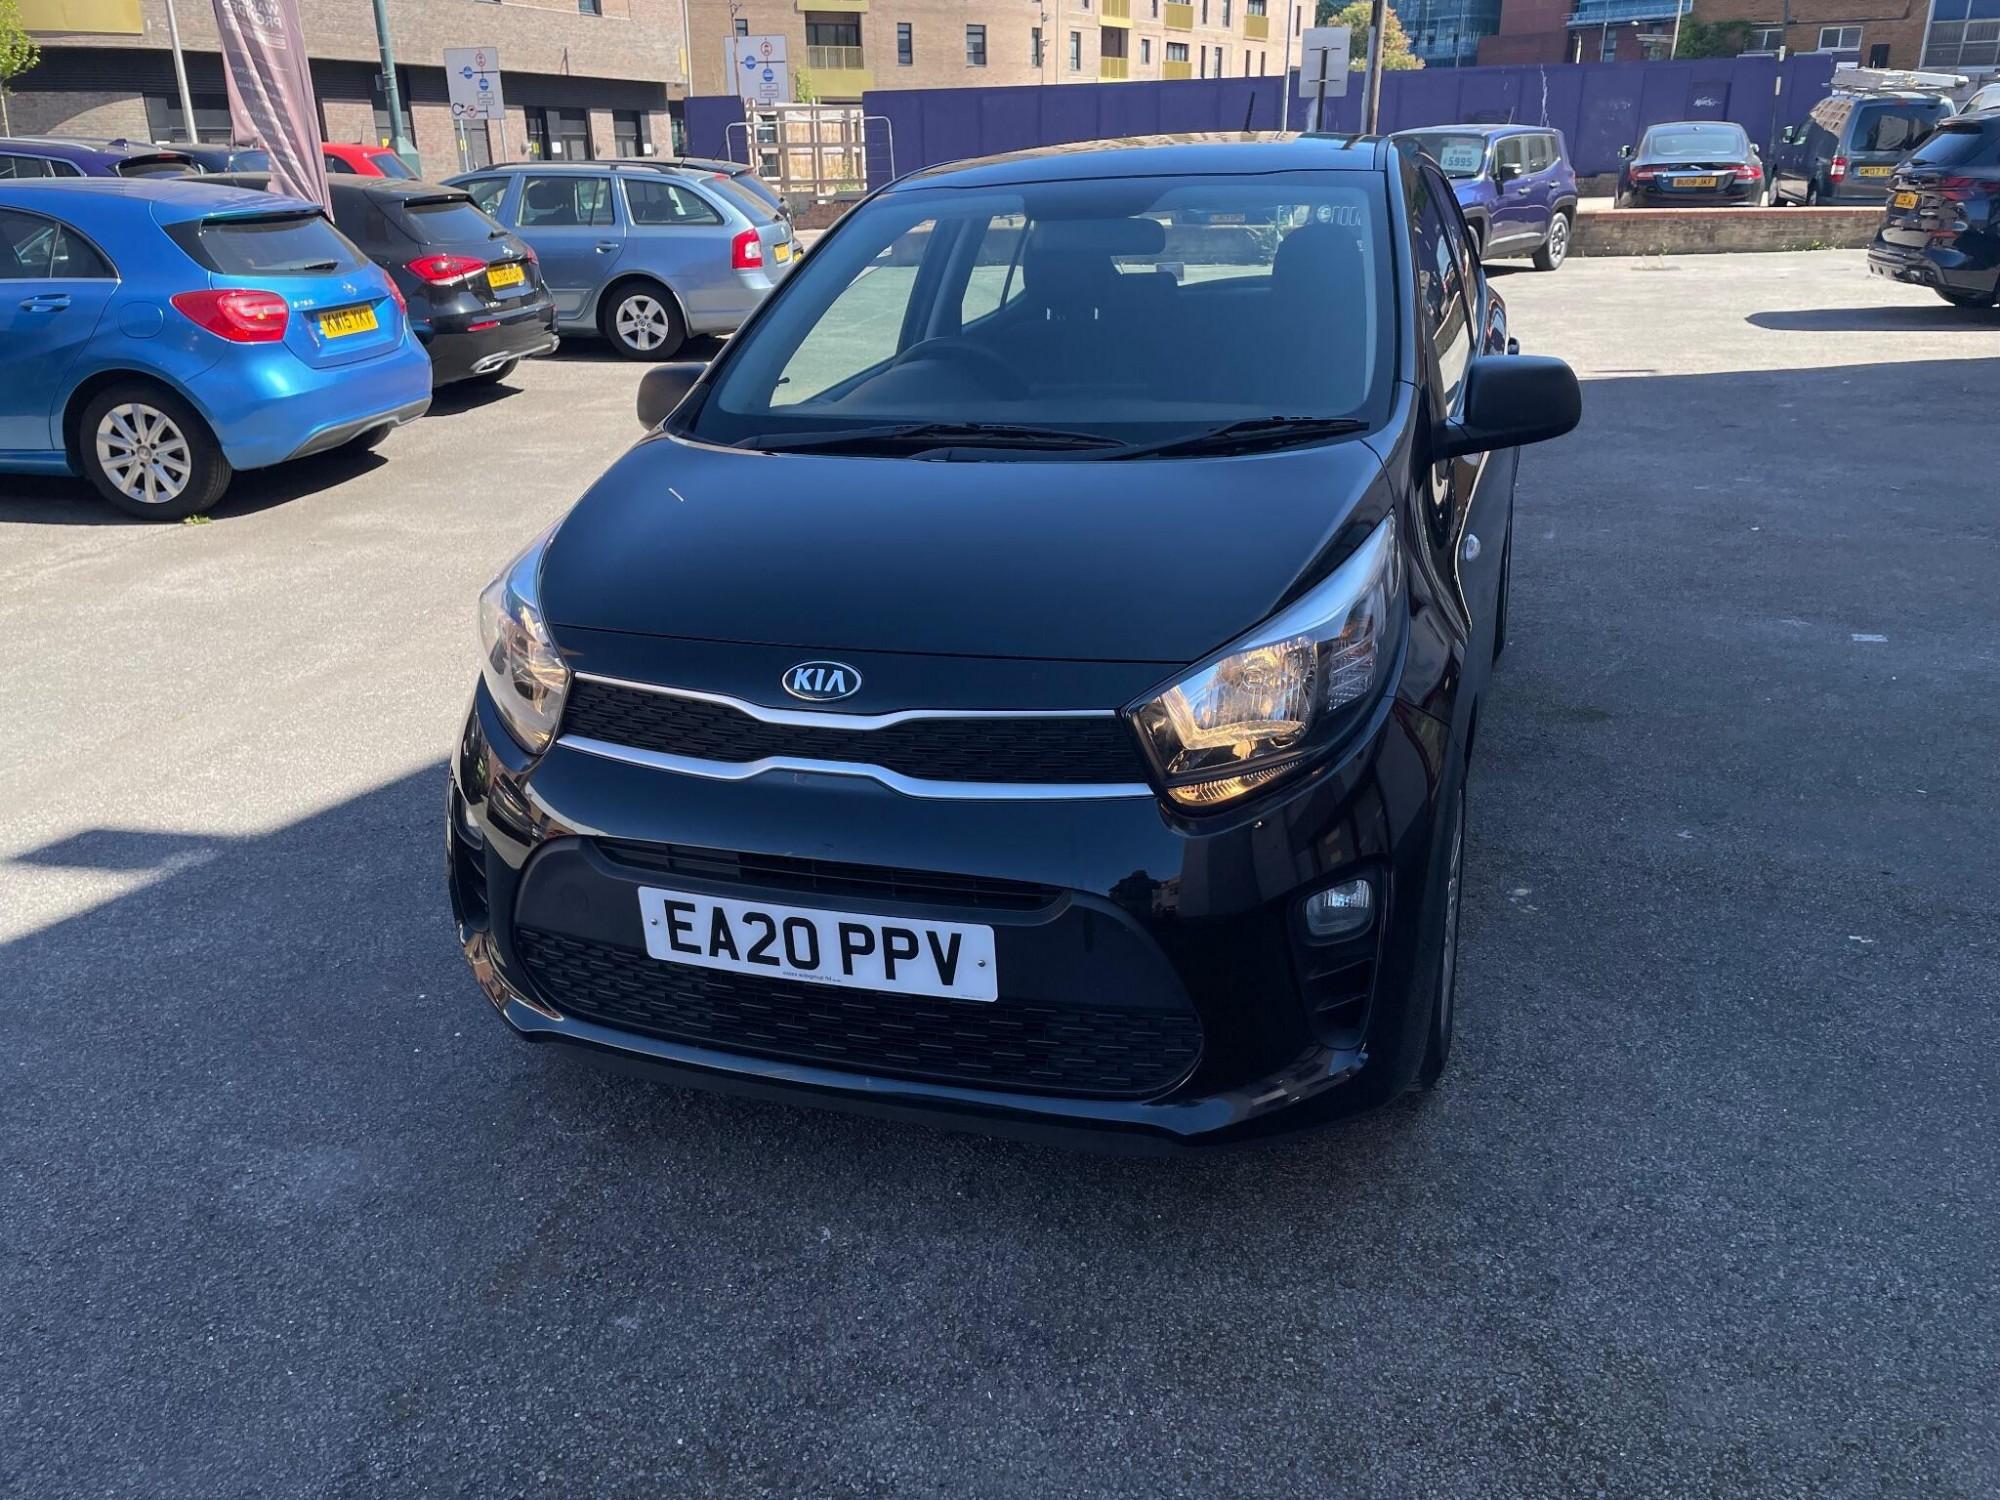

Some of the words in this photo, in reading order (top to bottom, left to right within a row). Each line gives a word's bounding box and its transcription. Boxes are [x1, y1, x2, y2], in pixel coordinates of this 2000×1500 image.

[323, 311, 353, 333] KW15
[793, 668, 846, 693] KIA
[664, 898, 820, 971] EA20
[838, 921, 962, 986] PPV
